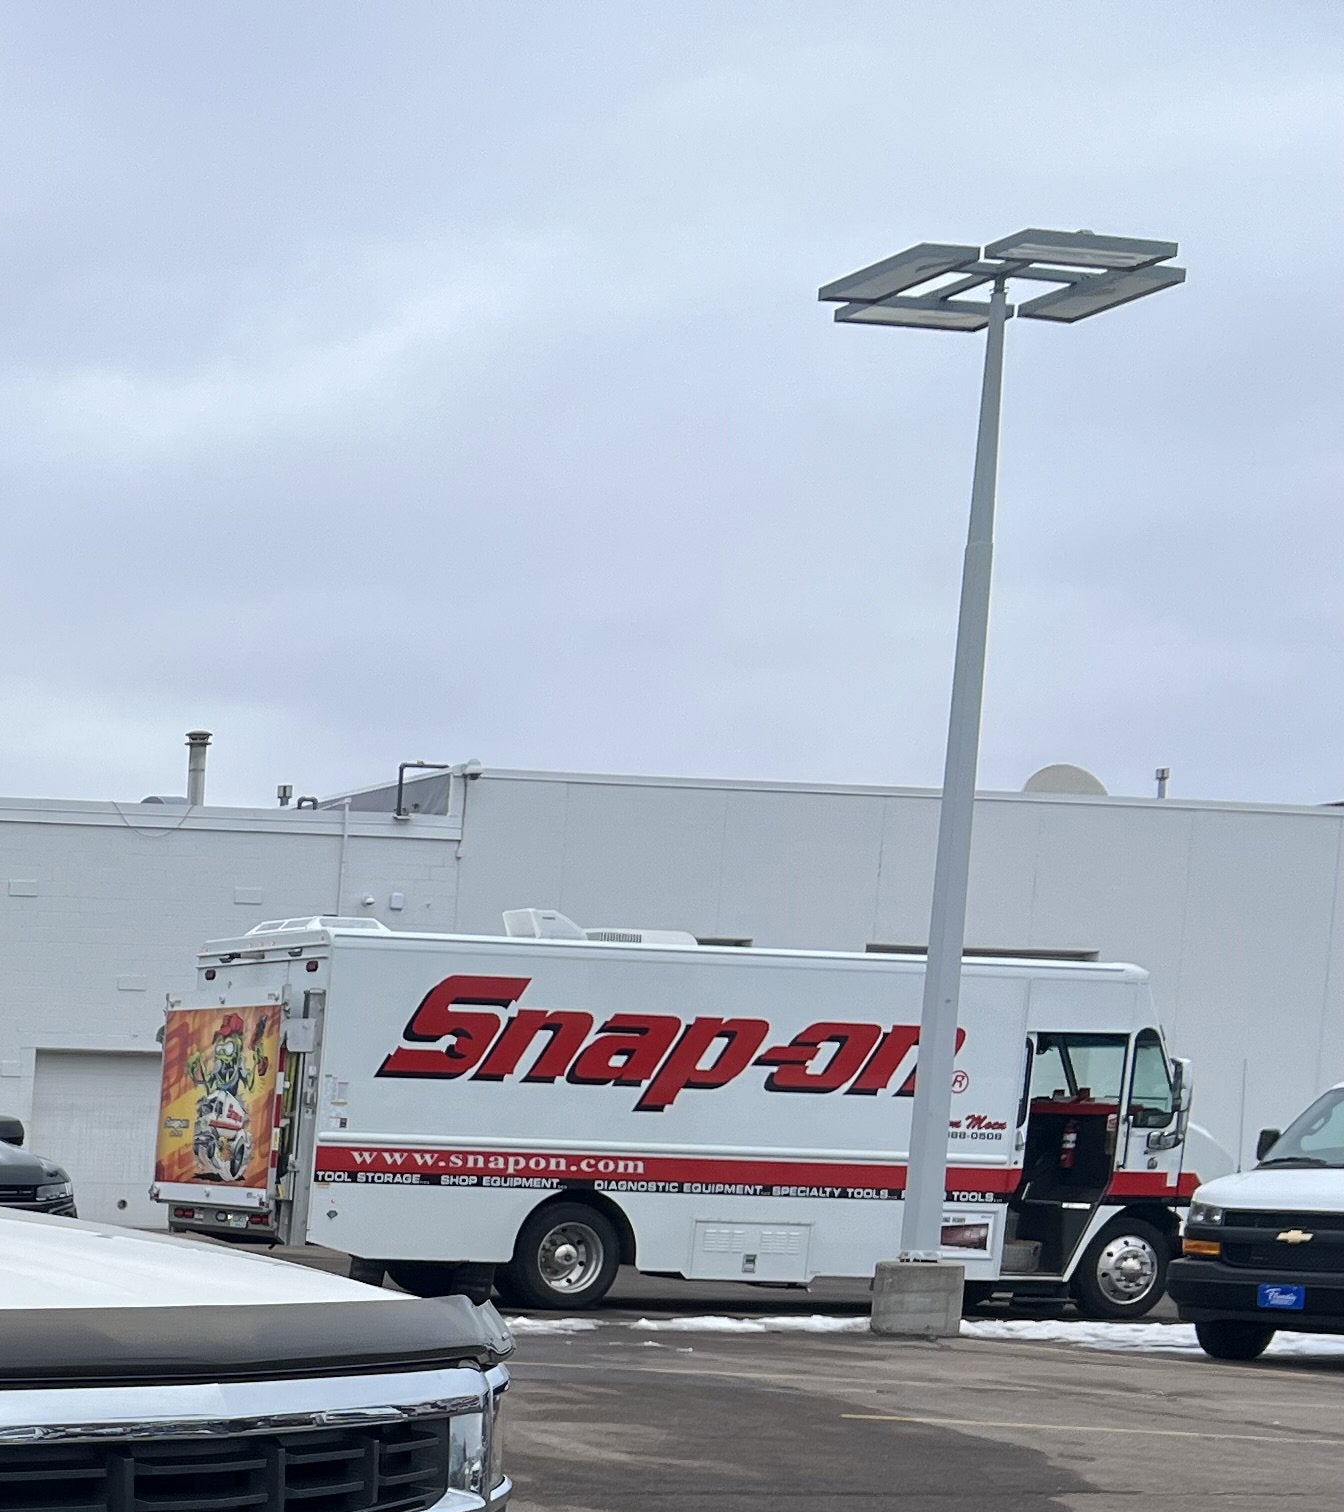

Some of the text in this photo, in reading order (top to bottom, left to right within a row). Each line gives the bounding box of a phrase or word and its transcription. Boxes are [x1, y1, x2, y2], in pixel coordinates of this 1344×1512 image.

[350, 1150, 645, 1175] www.snapon.com
[316, 1171, 352, 1182] TOOL
[440, 1175, 478, 1186] SHOP
[594, 1179, 679, 1192] DIAGNOSTIC
[772, 1186, 841, 1198] SPECIALTY
